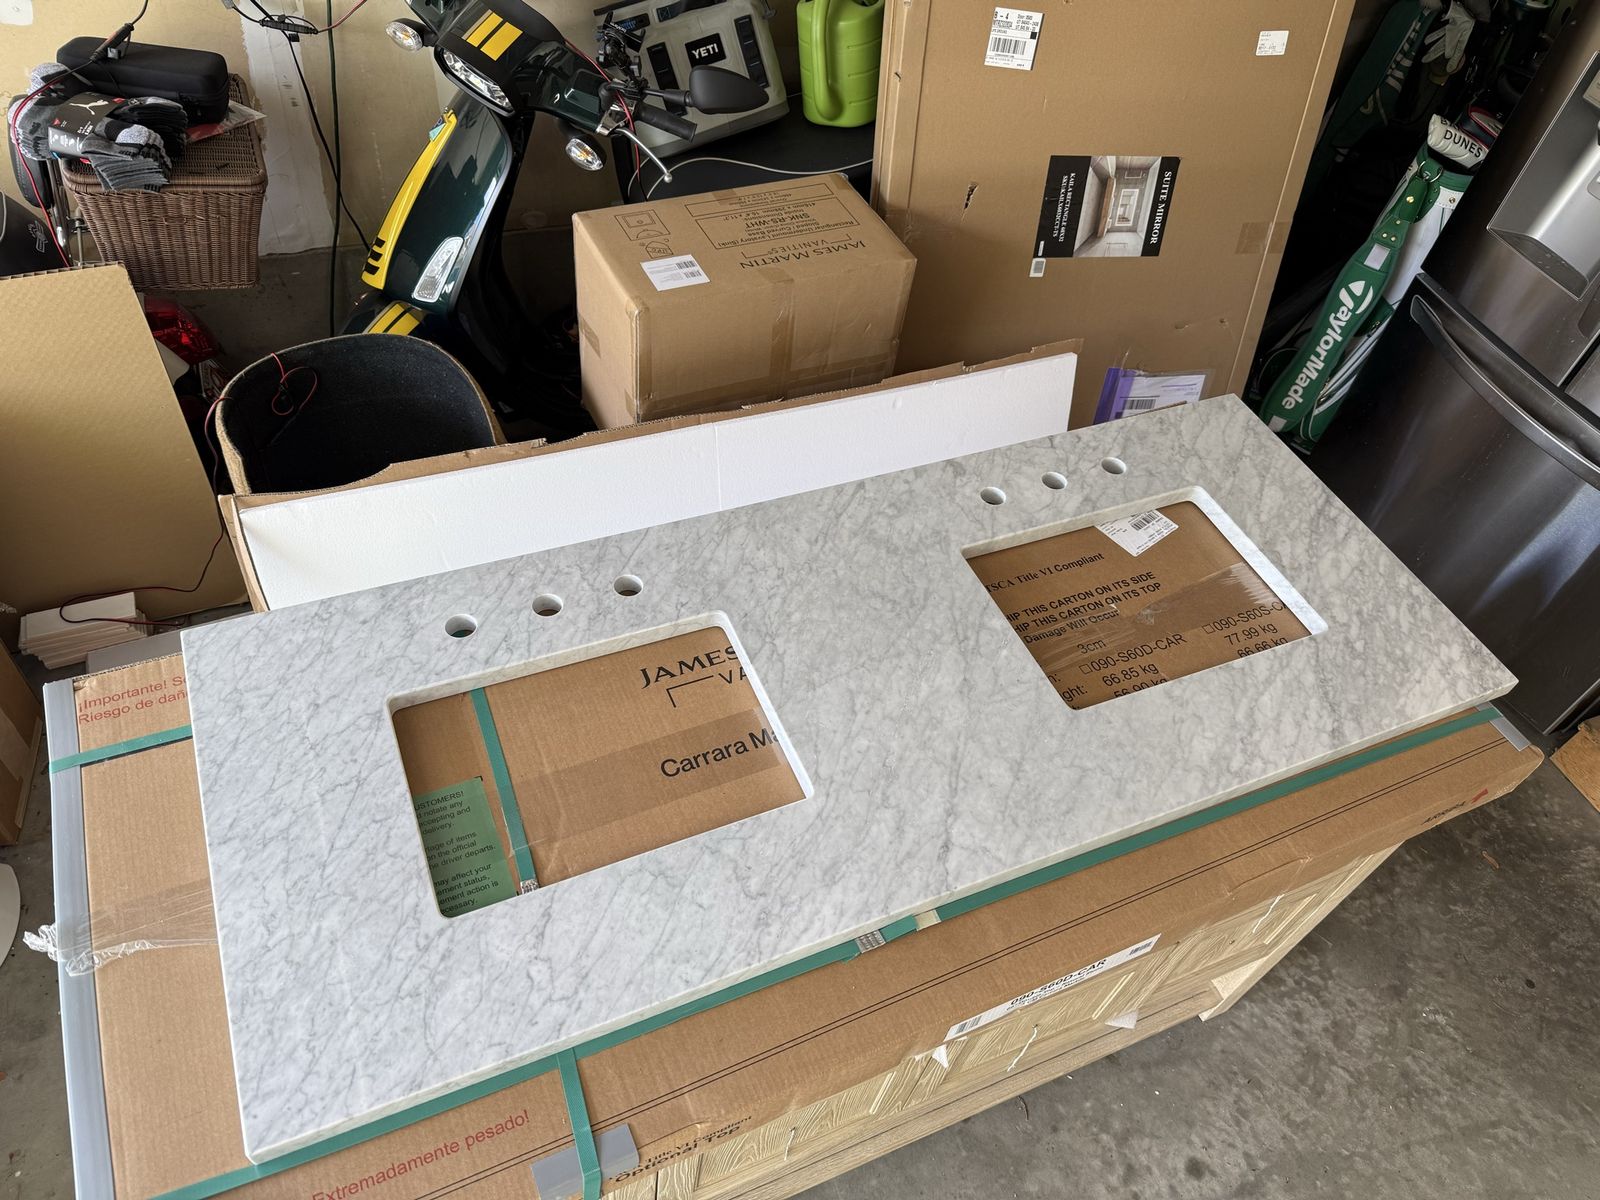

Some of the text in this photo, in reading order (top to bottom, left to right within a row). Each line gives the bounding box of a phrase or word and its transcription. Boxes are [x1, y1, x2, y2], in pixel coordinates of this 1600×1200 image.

[691, 43, 719, 59] YETI
[1443, 129, 1483, 158] DUNES
[1149, 171, 1173, 245] SUITE MIRROR
[740, 240, 867, 269] JAMES MARTIN
[1281, 280, 1374, 410] TaylorMade
[1014, 570, 1040, 586] Title
[1039, 565, 1054, 578] VI
[1054, 552, 1105, 573] Compliant
[1022, 602, 1049, 619] THIS
[1049, 590, 1094, 610] CARTON
[1094, 584, 1112, 596] ON
[1112, 578, 1131, 592] ITS
[1130, 571, 1157, 587] SIDE
[1034, 613, 1059, 629] THIS
[1058, 600, 1104, 621] CARTON
[1104, 594, 1122, 606] ON
[1121, 588, 1141, 602] ITS
[1139, 581, 1162, 595] TOP
[1023, 609, 1120, 645] Damage Will Occur
[1076, 638, 1107, 655] 3cm
[1089, 632, 1188, 673] 090-S60D-CAR
[1101, 667, 1141, 688] 66.85
[1140, 661, 1160, 680] kg
[1222, 626, 1262, 647] 77.99
[1259, 621, 1279, 639] kg
[640, 645, 738, 690] JAMES
[78, 680, 168, 712] ¡Importante!
[78, 705, 131, 723] Riesgo
[135, 699, 154, 710] de
[660, 740, 749, 777] Carrara
[423, 805, 448, 816] notate
[449, 800, 464, 810] any
[456, 805, 471, 816] and
[437, 849, 450, 858] the
[451, 840, 478, 854] official
[446, 837, 454, 846] of
[455, 831, 477, 842] items
[440, 854, 464, 866] driver
[464, 844, 497, 858] departs.
[450, 869, 474, 882] affect
[473, 863, 492, 876] your
[466, 883, 491, 896] action
[491, 880, 500, 889] is
[1010, 958, 1107, 1006] 090-S60D-CAR
[693, 1115, 753, 1143] Compliant
[312, 1109, 531, 1200] Extremadamente pesado!
[614, 1142, 699, 1182] Optional
[702, 1125, 741, 1144] Top
